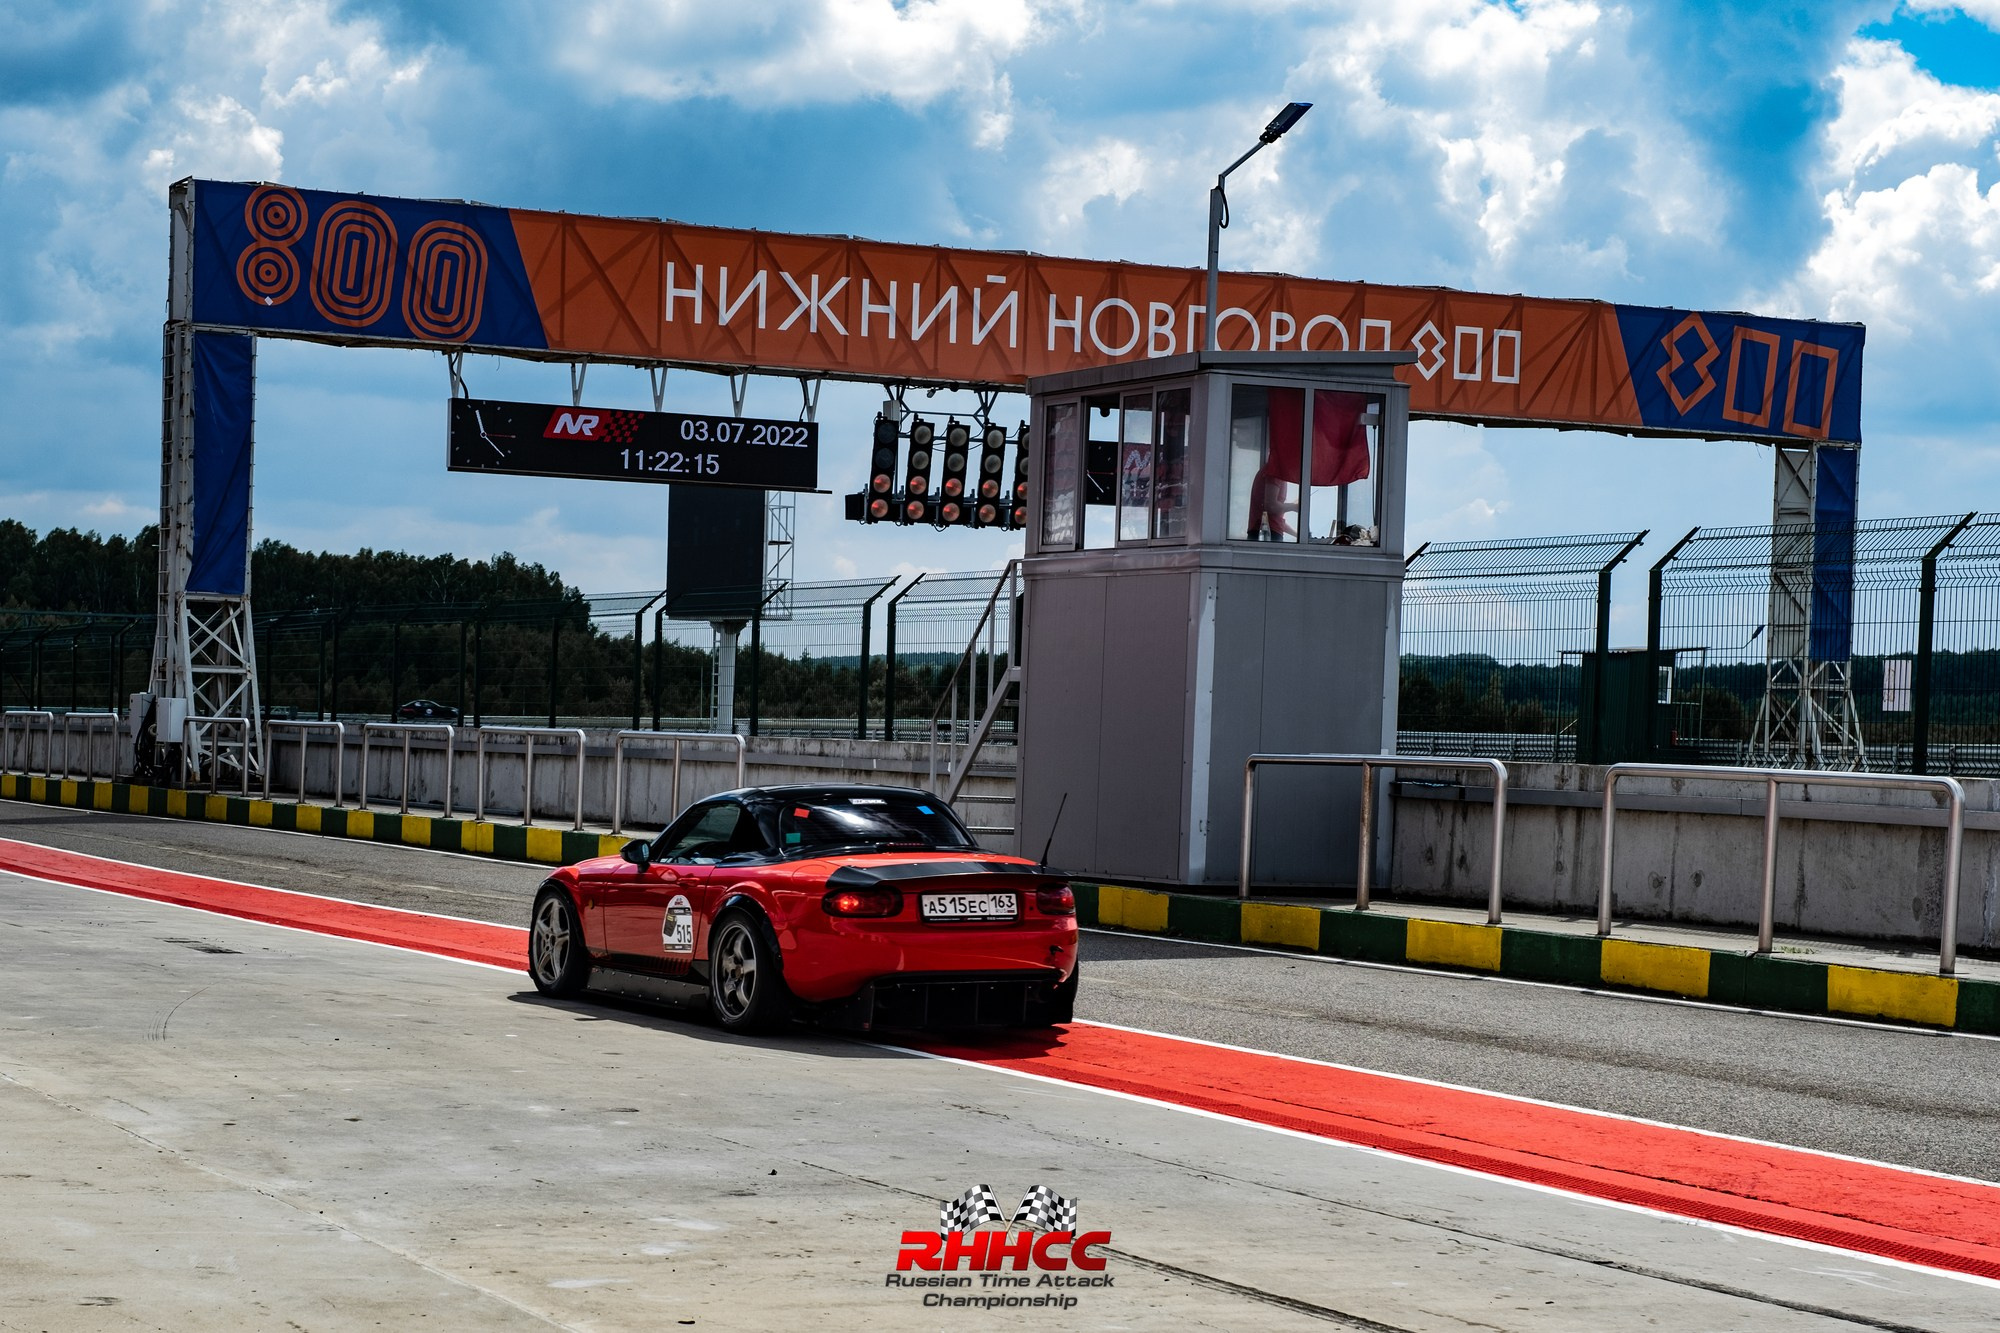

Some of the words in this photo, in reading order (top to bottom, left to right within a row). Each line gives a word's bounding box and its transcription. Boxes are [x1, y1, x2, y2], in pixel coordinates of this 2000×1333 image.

[236, 186, 488, 343] 800
[665, 262, 1018, 349] НИЖНИЙ
[1410, 320, 1522, 384] 800
[1656, 312, 1838, 440] 800
[553, 413, 600, 437] NR
[680, 419, 808, 448] 03.07.2022
[620, 449, 719, 475] 11:22:15
[991, 896, 1014, 908] 163
[676, 924, 691, 943] 515
